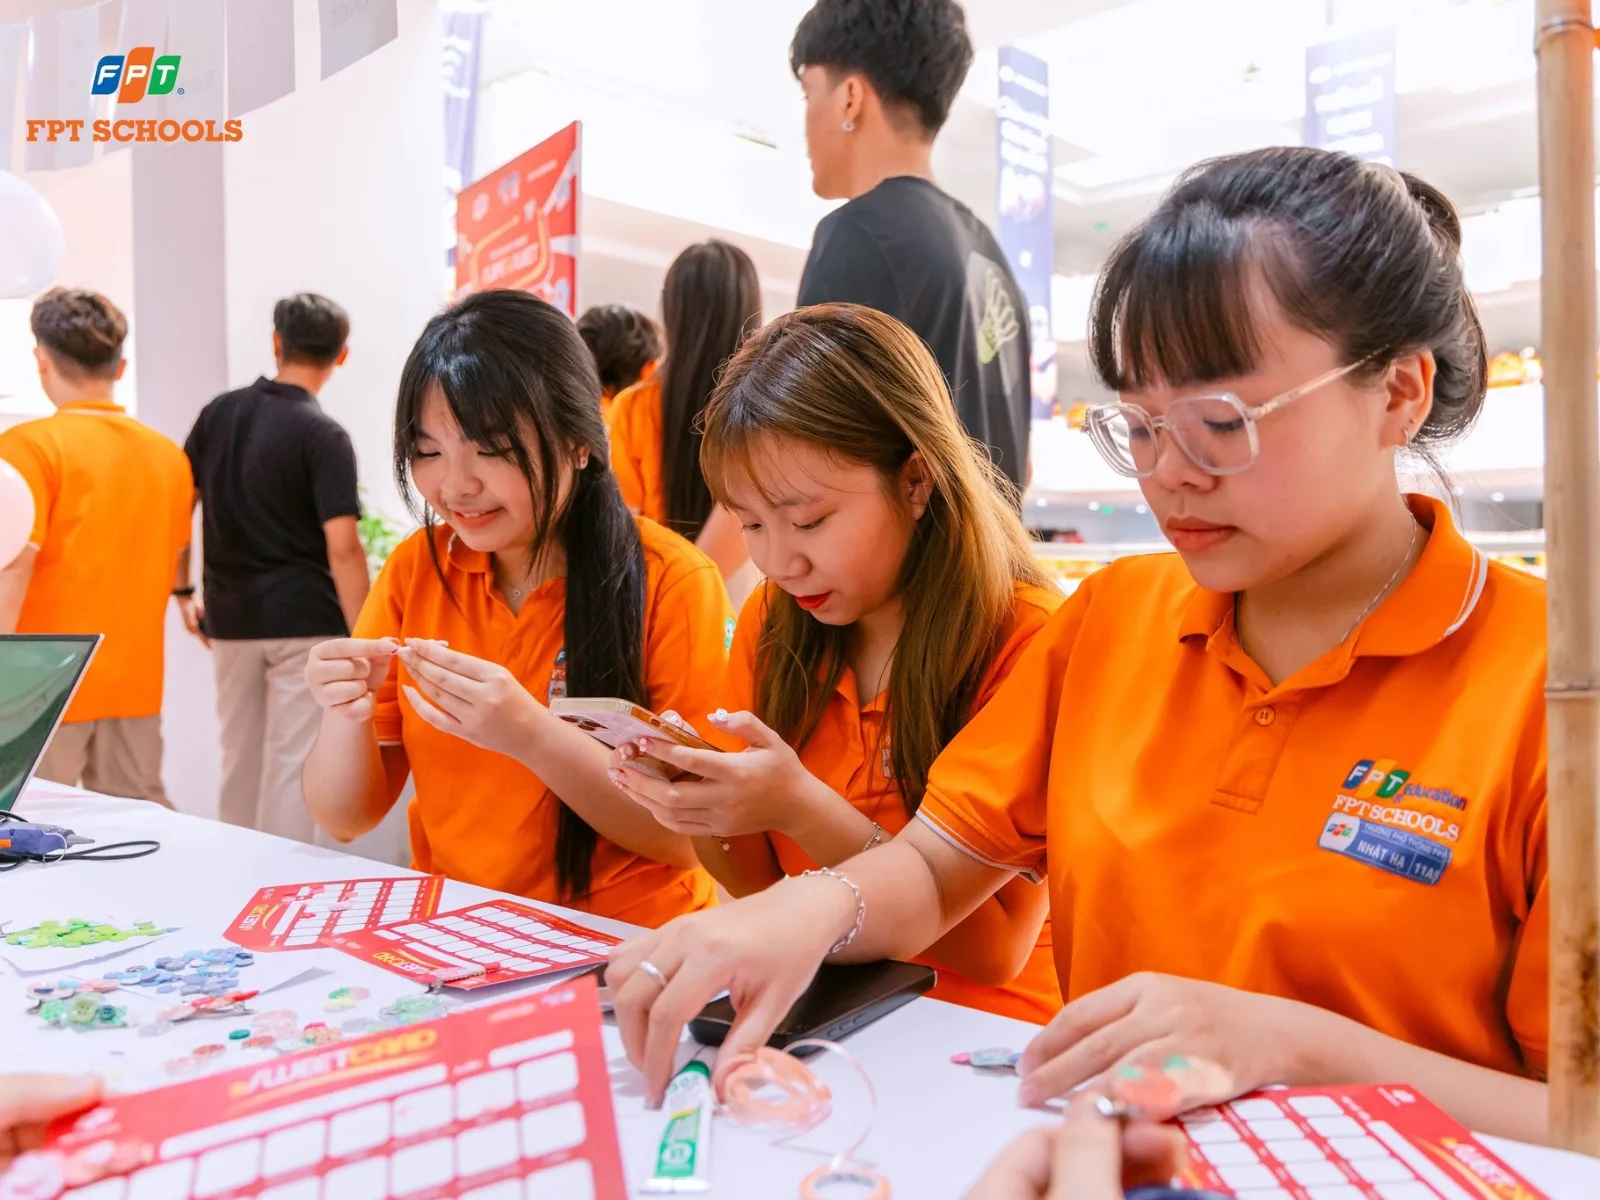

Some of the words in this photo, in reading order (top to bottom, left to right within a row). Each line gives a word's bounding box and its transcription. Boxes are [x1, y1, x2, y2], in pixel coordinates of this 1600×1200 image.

[1347, 765, 1405, 792] FPT
[1332, 793, 1371, 817] FPT
[1370, 806, 1460, 842] SCHOOLS
